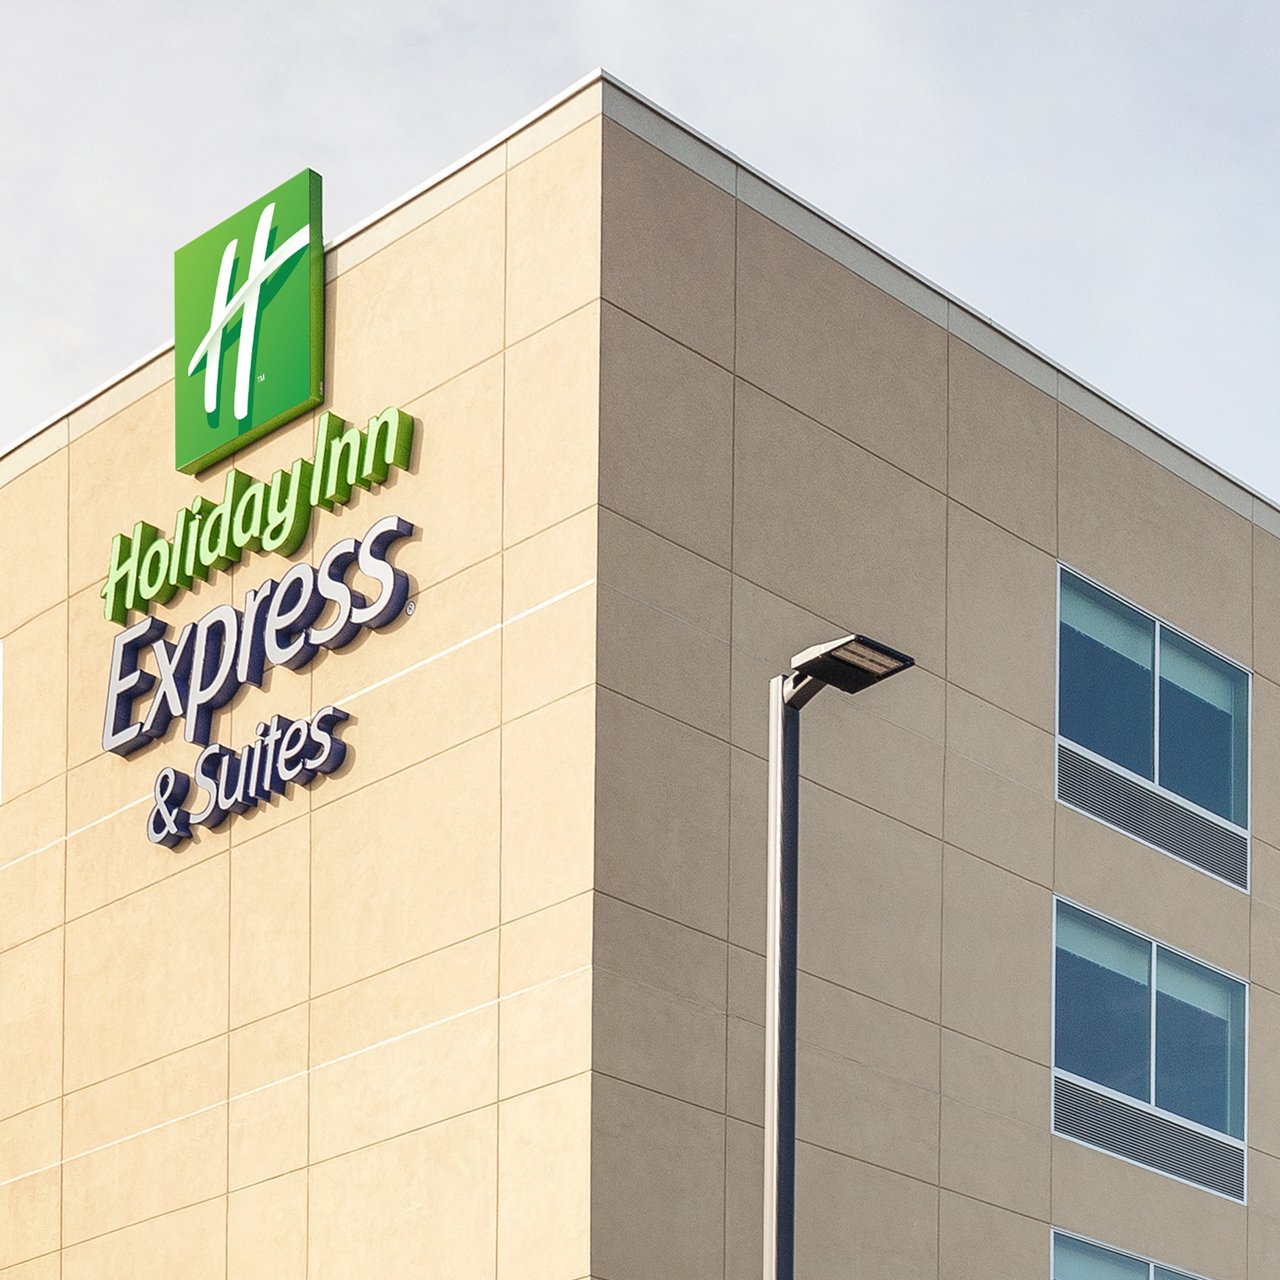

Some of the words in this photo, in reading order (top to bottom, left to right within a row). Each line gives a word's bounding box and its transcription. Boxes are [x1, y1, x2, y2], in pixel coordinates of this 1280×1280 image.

[100, 458, 310, 625] Holiday
[310, 406, 412, 512] Inn
[102, 516, 413, 760] Express
[147, 766, 190, 850] &
[189, 705, 348, 828] Suites
